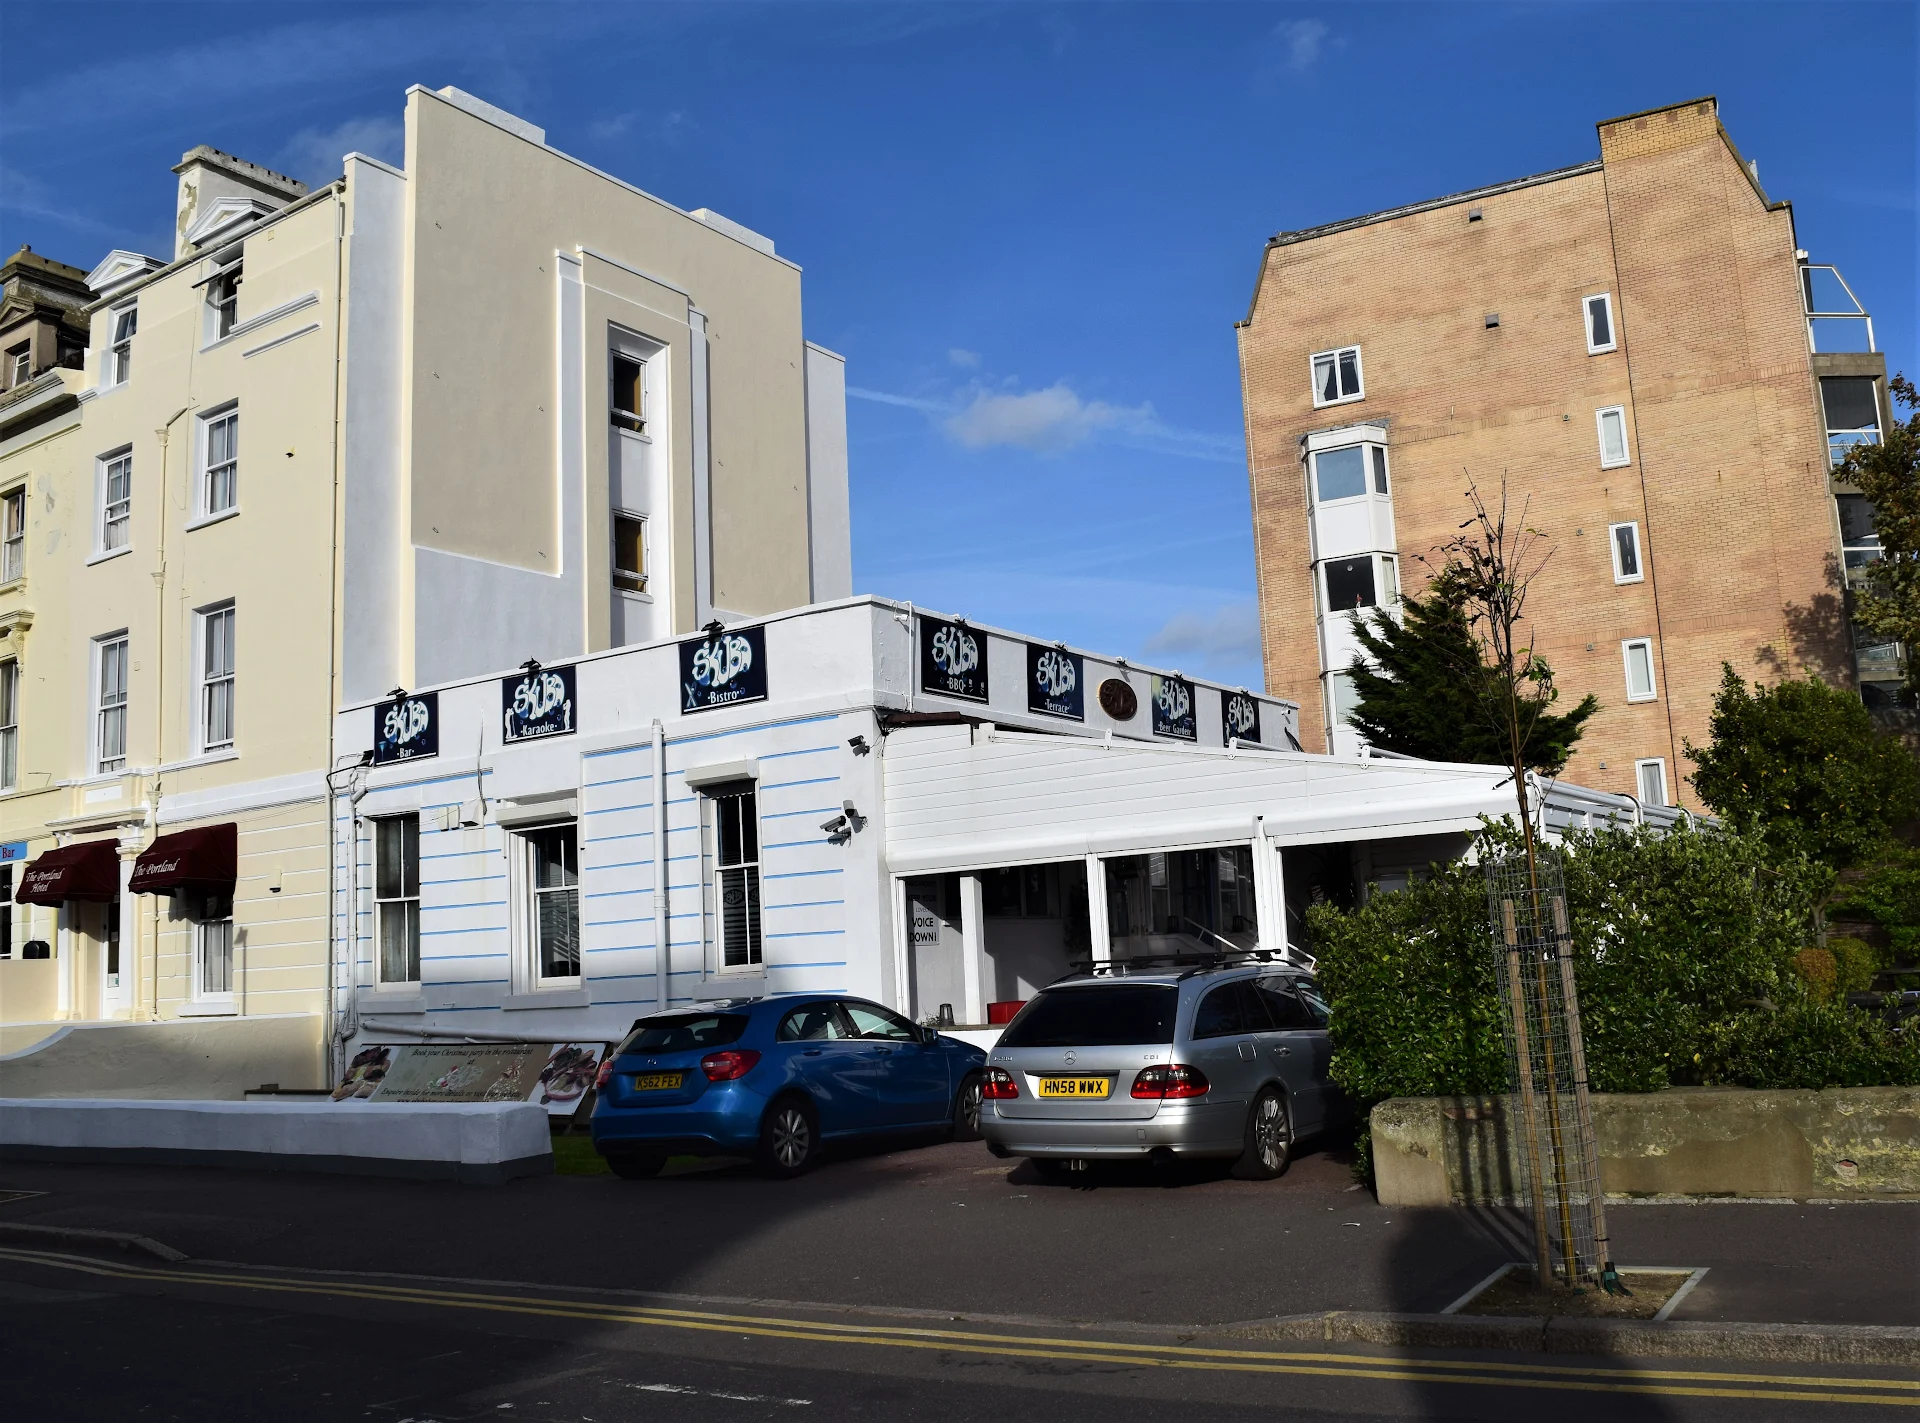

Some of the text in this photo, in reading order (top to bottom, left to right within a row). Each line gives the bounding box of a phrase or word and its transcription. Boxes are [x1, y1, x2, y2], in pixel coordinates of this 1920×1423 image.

[948, 677, 965, 694] BBQ
[709, 689, 738, 704] Bistro
[1045, 699, 1069, 714] Terrace
[522, 722, 557, 736] Karaoke
[1159, 721, 1191, 736] Beer Garden
[399, 746, 413, 759] Bar
[2, 847, 16, 859] Bar
[26, 867, 65, 882] The Portland
[133, 857, 182, 878] The Portland
[30, 880, 51, 893] Hotel
[911, 917, 934, 928] VOICE
[909, 932, 937, 943] DOWN!
[413, 1048, 428, 1056] Book
[427, 1050, 441, 1058] your
[441, 1048, 468, 1056] Christmas
[468, 1049, 483, 1058] party
[492, 1048, 501, 1056] the
[502, 1048, 534, 1056] restaurant
[637, 1073, 681, 1089] KS62 FEX
[1044, 1079, 1103, 1094] HN58 WWX
[381, 1088, 404, 1097] Enquire
[421, 1089, 431, 1097] for
[445, 1089, 465, 1097] details
